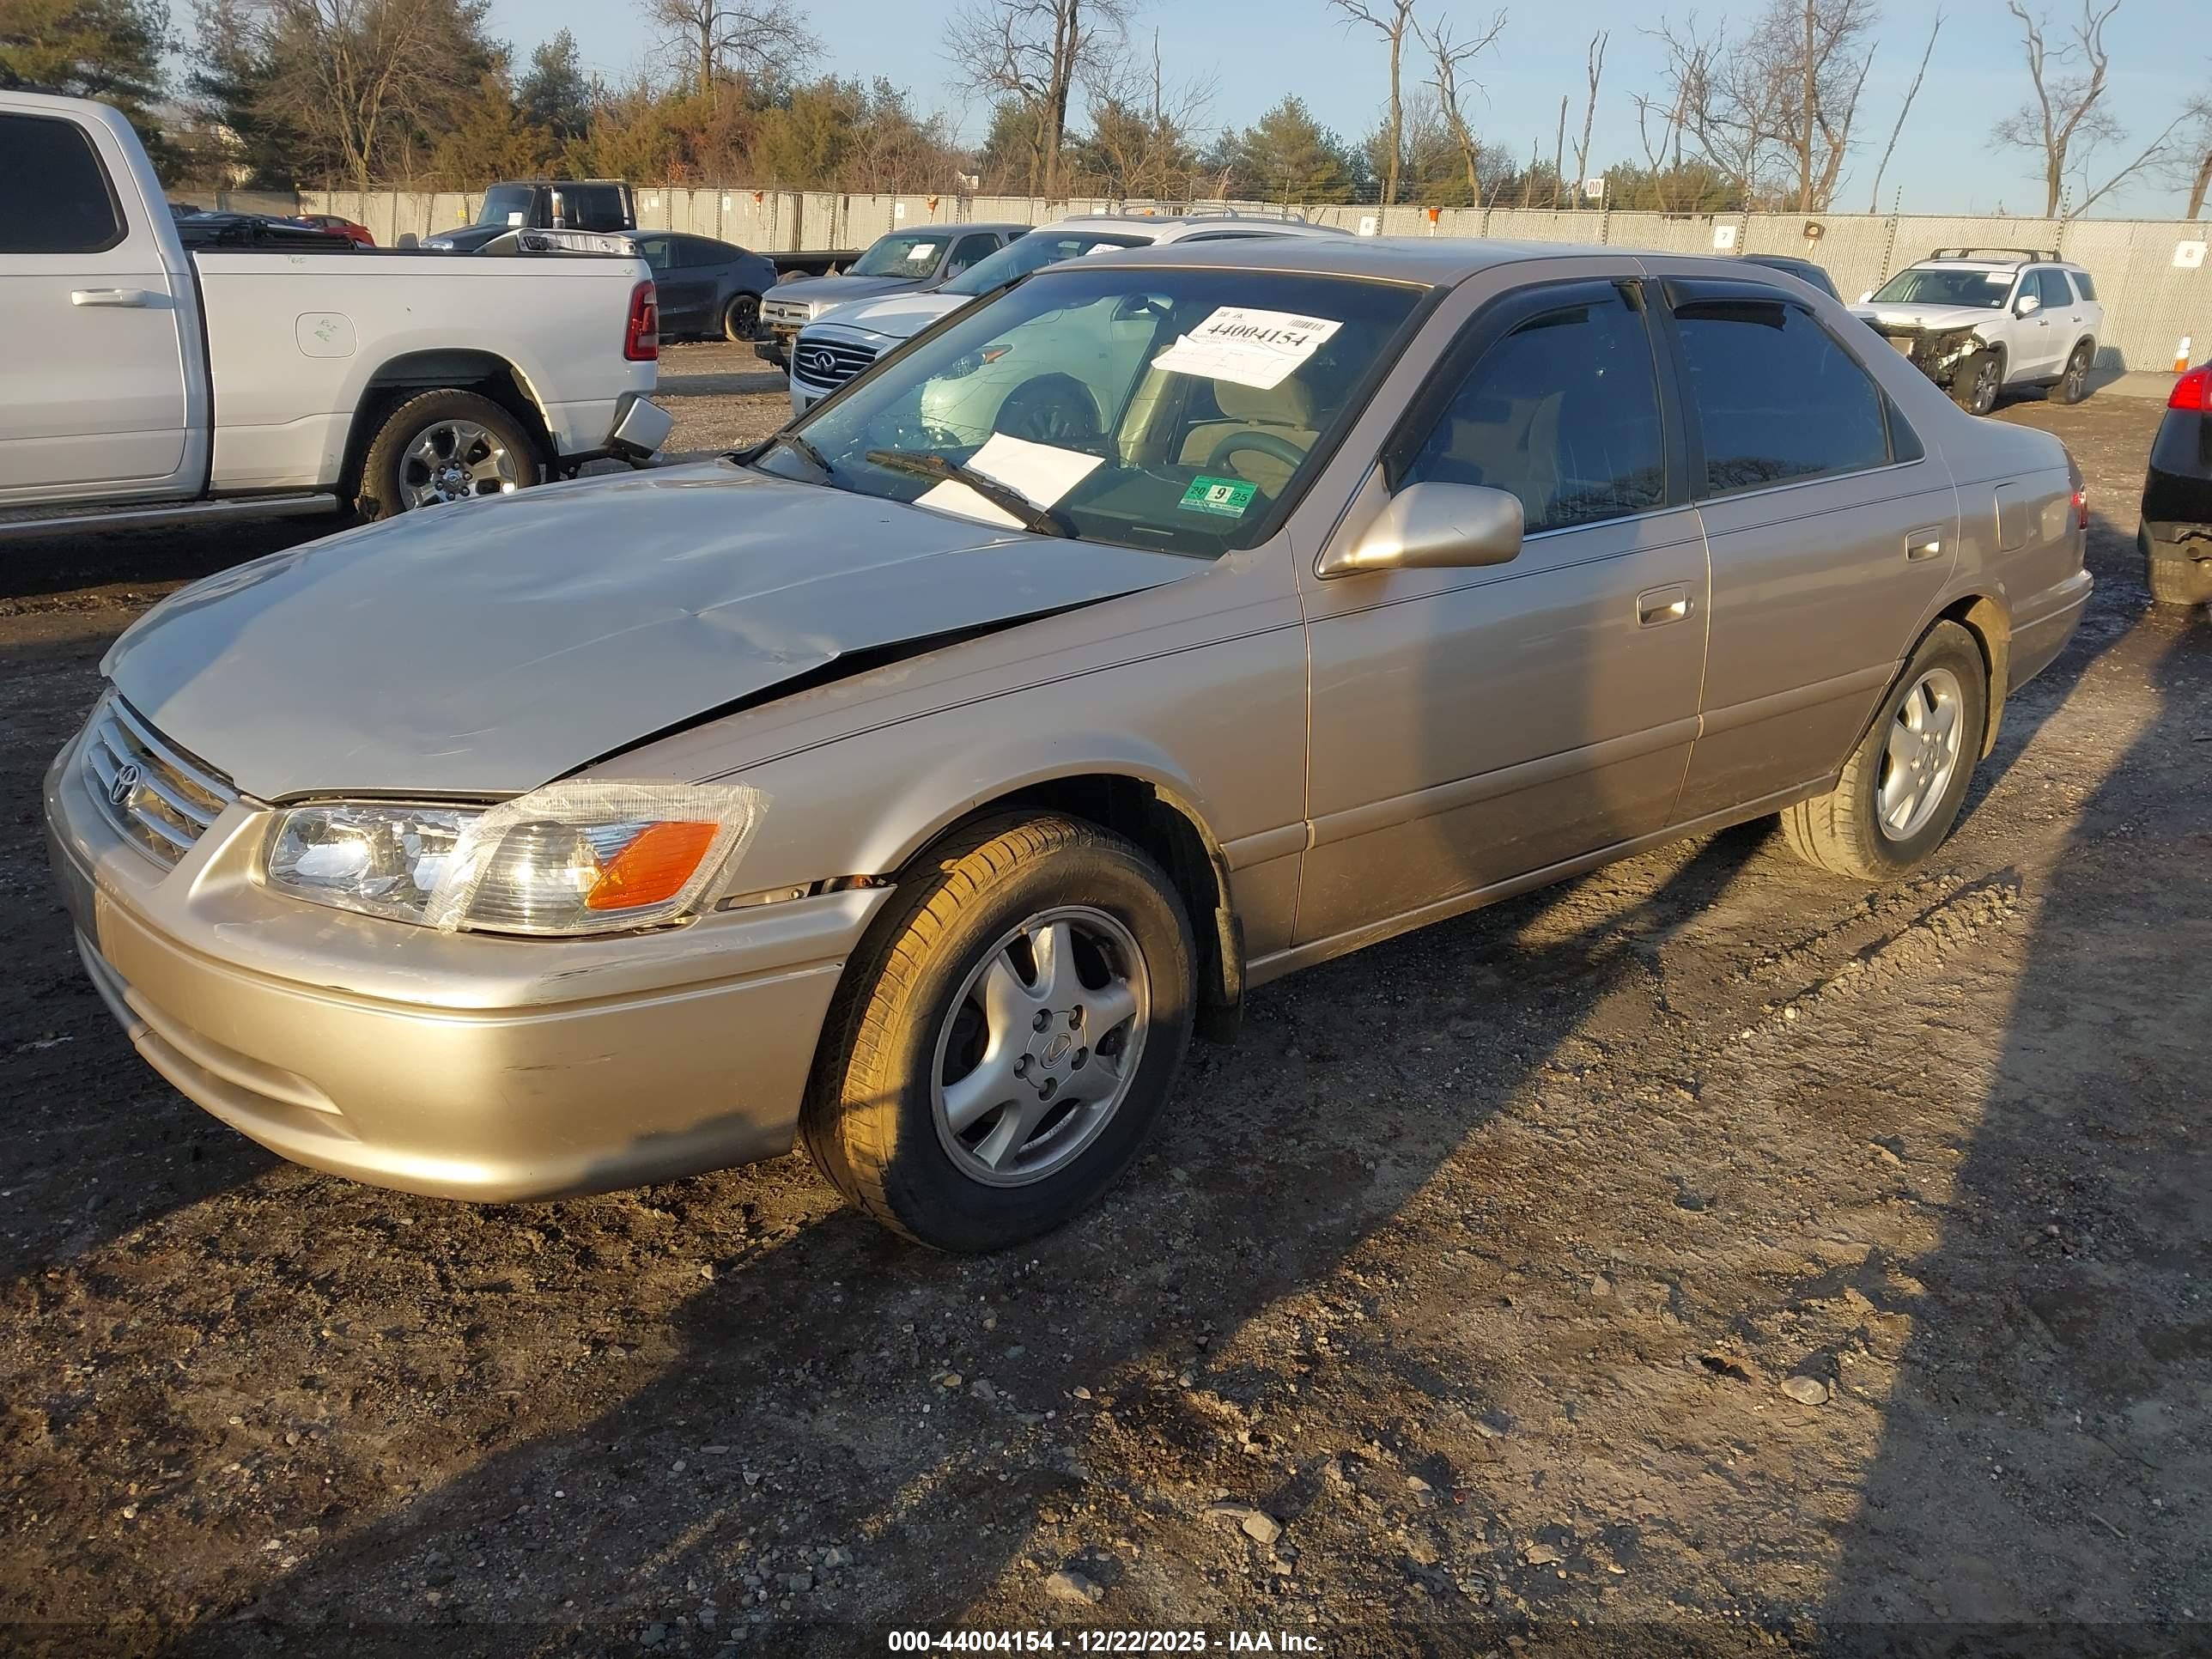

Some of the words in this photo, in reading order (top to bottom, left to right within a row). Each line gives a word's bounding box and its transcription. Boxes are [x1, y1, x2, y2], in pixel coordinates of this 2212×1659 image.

[1589, 180, 1601, 195] DD
[1722, 232, 1729, 240] 7
[2185, 248, 2195, 258] 8
[1207, 322, 1310, 347] 44004154
[1190, 486, 1206, 496] 20
[1214, 487, 1227, 500] 9
[1232, 493, 1249, 502] 25
